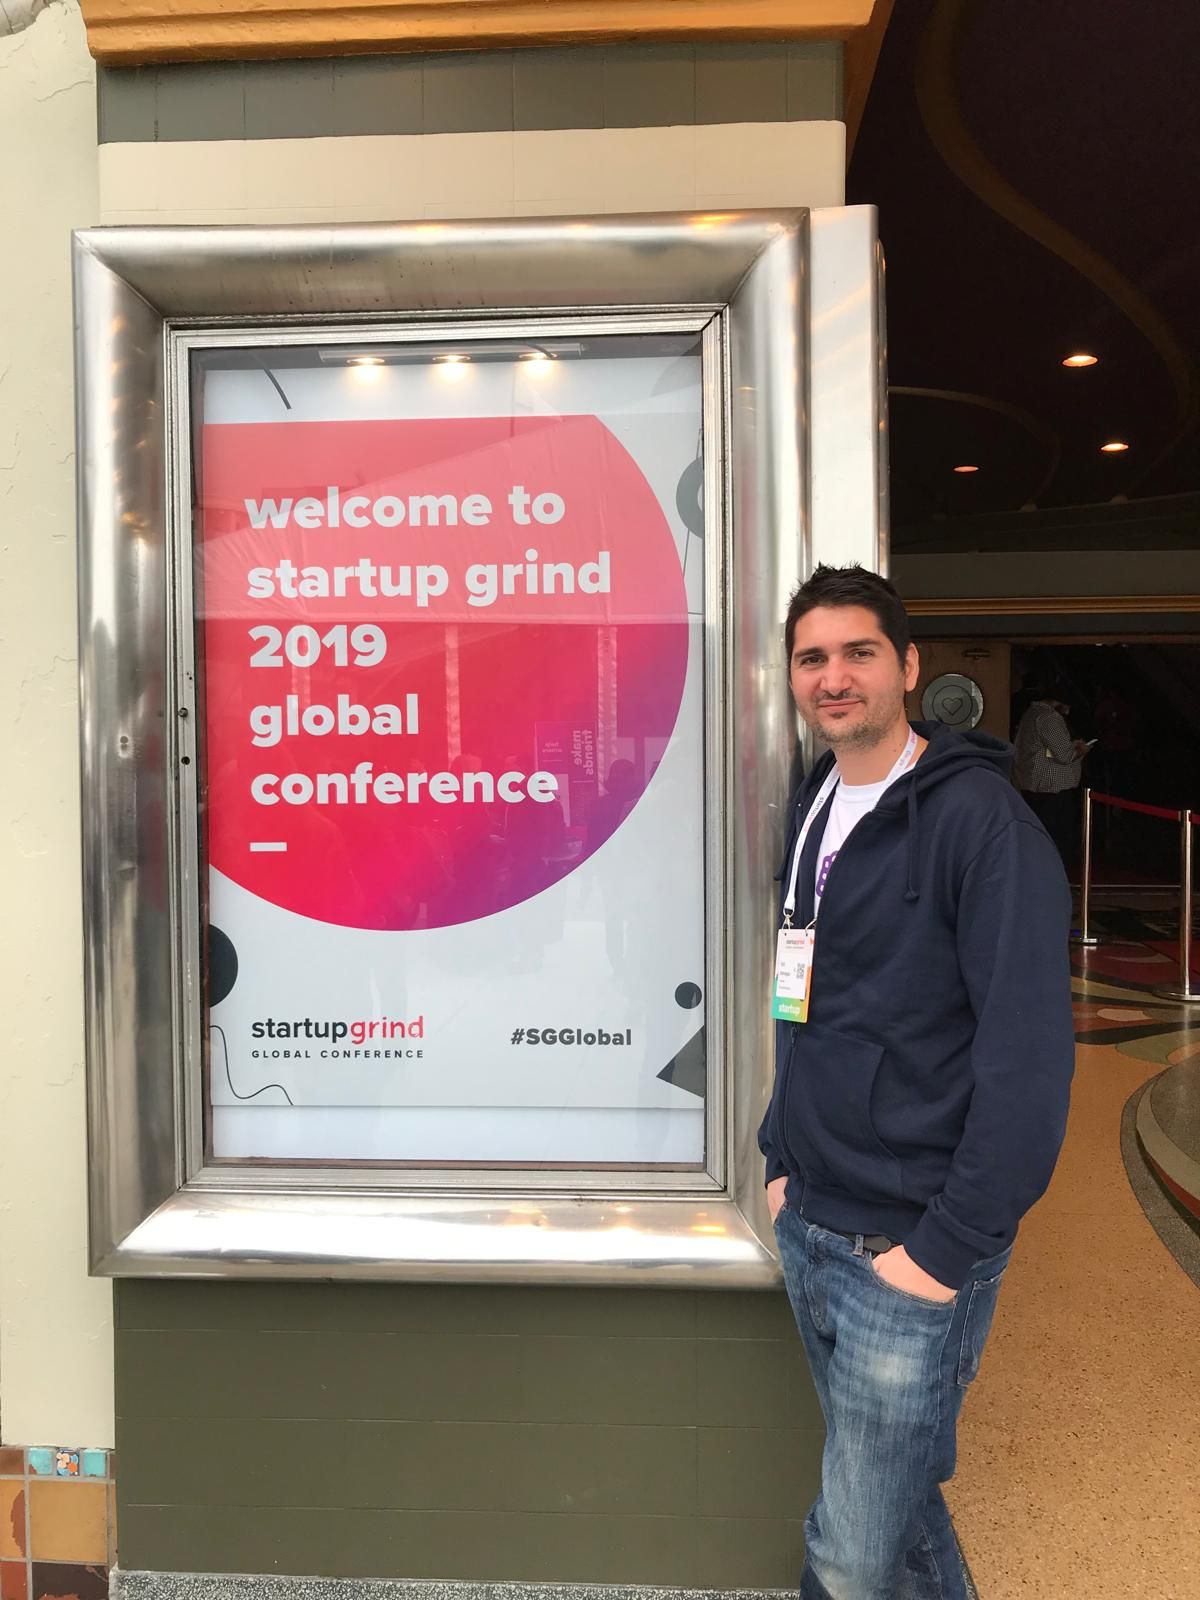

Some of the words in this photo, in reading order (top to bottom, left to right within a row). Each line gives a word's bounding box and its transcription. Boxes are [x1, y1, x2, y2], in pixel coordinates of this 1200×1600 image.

[245, 486, 492, 529] welcome
[508, 485, 565, 526] to
[247, 558, 448, 607] startup
[465, 548, 611, 606] grind
[248, 624, 387, 668] 2019
[249, 693, 419, 748] global
[250, 762, 559, 804] conference
[251, 1016, 424, 1045] startupgrind
[510, 1028, 632, 1047] #SGGlobal
[251, 1049, 312, 1059] GLOBAL
[320, 1049, 424, 1059] CONFERENCE
